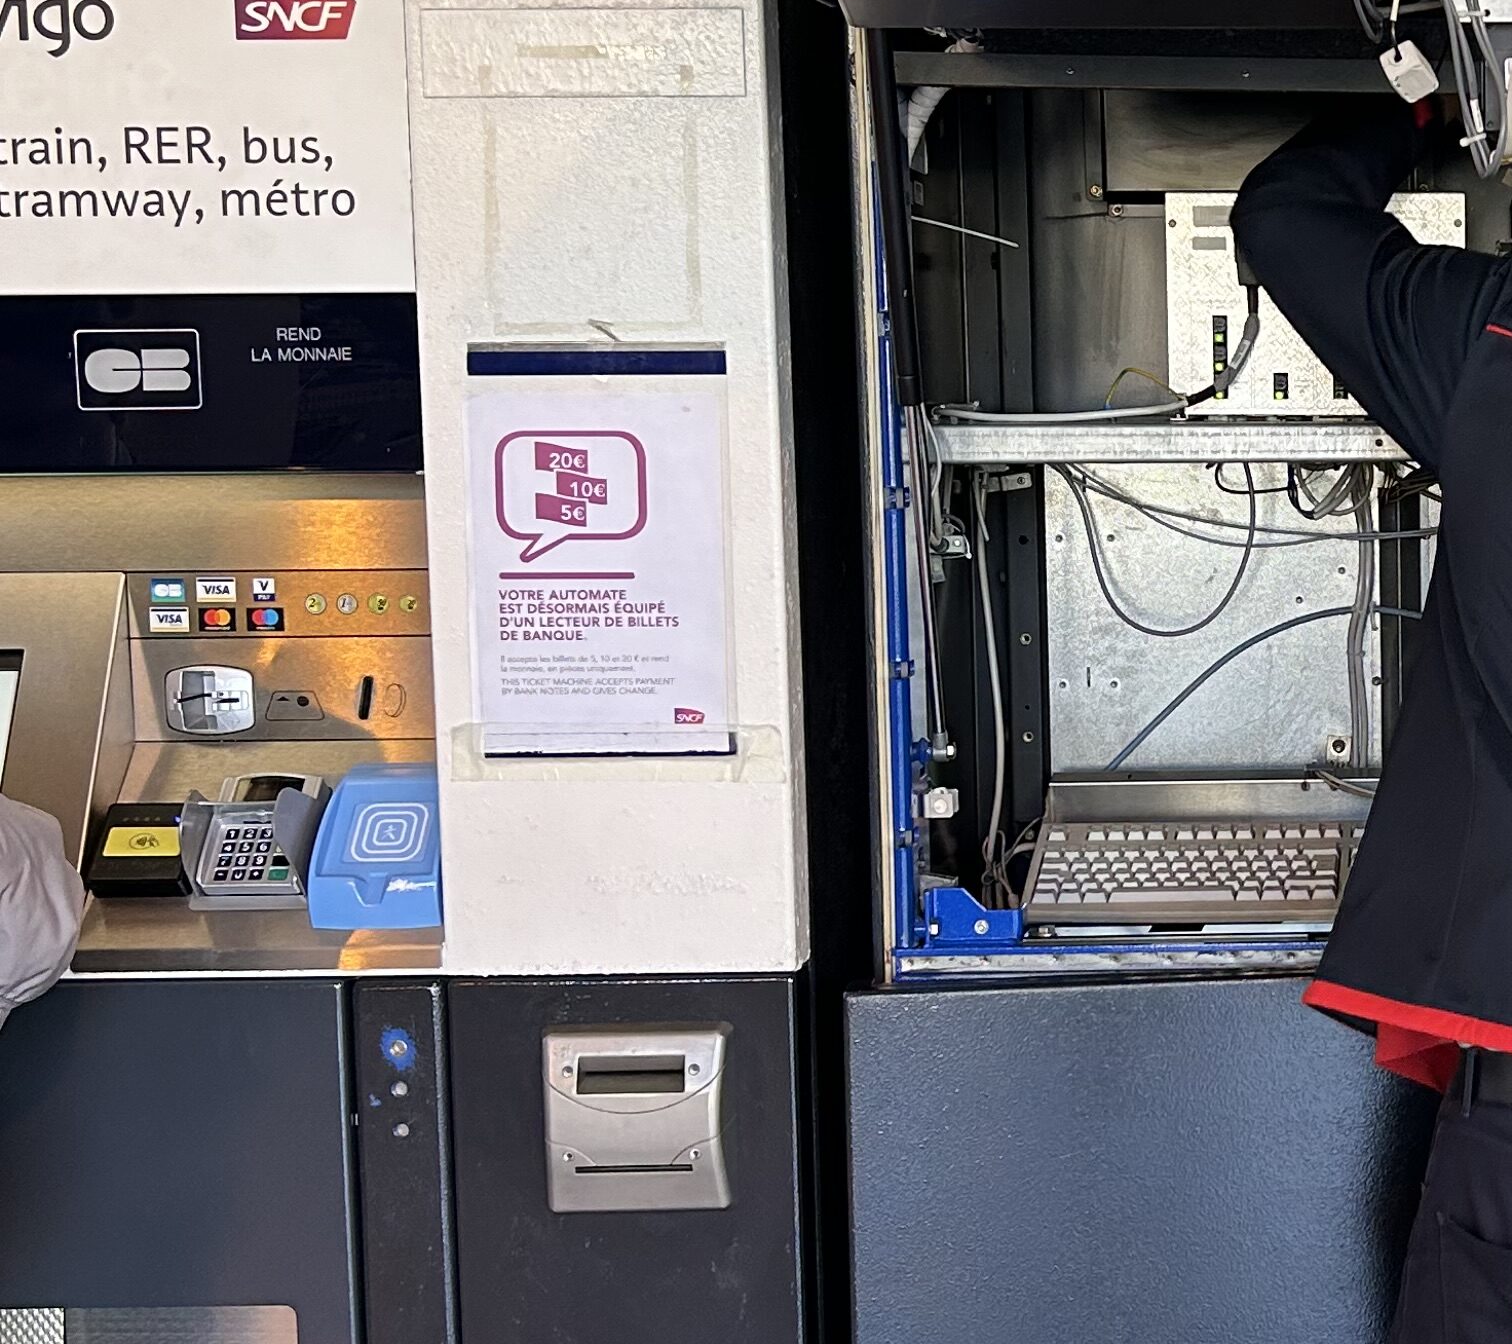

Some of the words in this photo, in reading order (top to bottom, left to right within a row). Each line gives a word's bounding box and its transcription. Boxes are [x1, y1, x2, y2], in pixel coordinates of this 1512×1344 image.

[240, 0, 349, 33] SNCF
[124, 126, 227, 173] RER,
[243, 126, 334, 173] bus,
[221, 179, 356, 217] métro
[276, 327, 321, 342] REND
[251, 347, 271, 362] LA
[277, 346, 352, 362] MONNAIE
[549, 452, 585, 469] 20€
[570, 481, 606, 498] 10€
[560, 504, 585, 521] 5€
[202, 584, 230, 595] VISA
[499, 589, 545, 601] VOTRE
[549, 589, 627, 601] AUTOMATE
[500, 603, 522, 614] EST
[527, 601, 610, 614] DÉSORMAIS
[614, 600, 666, 615] ÉQUIPÉ
[157, 613, 183, 624] VISA
[500, 616, 535, 628] D'UN
[539, 616, 600, 628] LECTEUR
[605, 616, 623, 628] DE
[628, 616, 680, 628] BILLETS
[500, 630, 518, 641] DE
[523, 630, 588, 643] BANQUE.
[676, 713, 703, 723] SNCF
